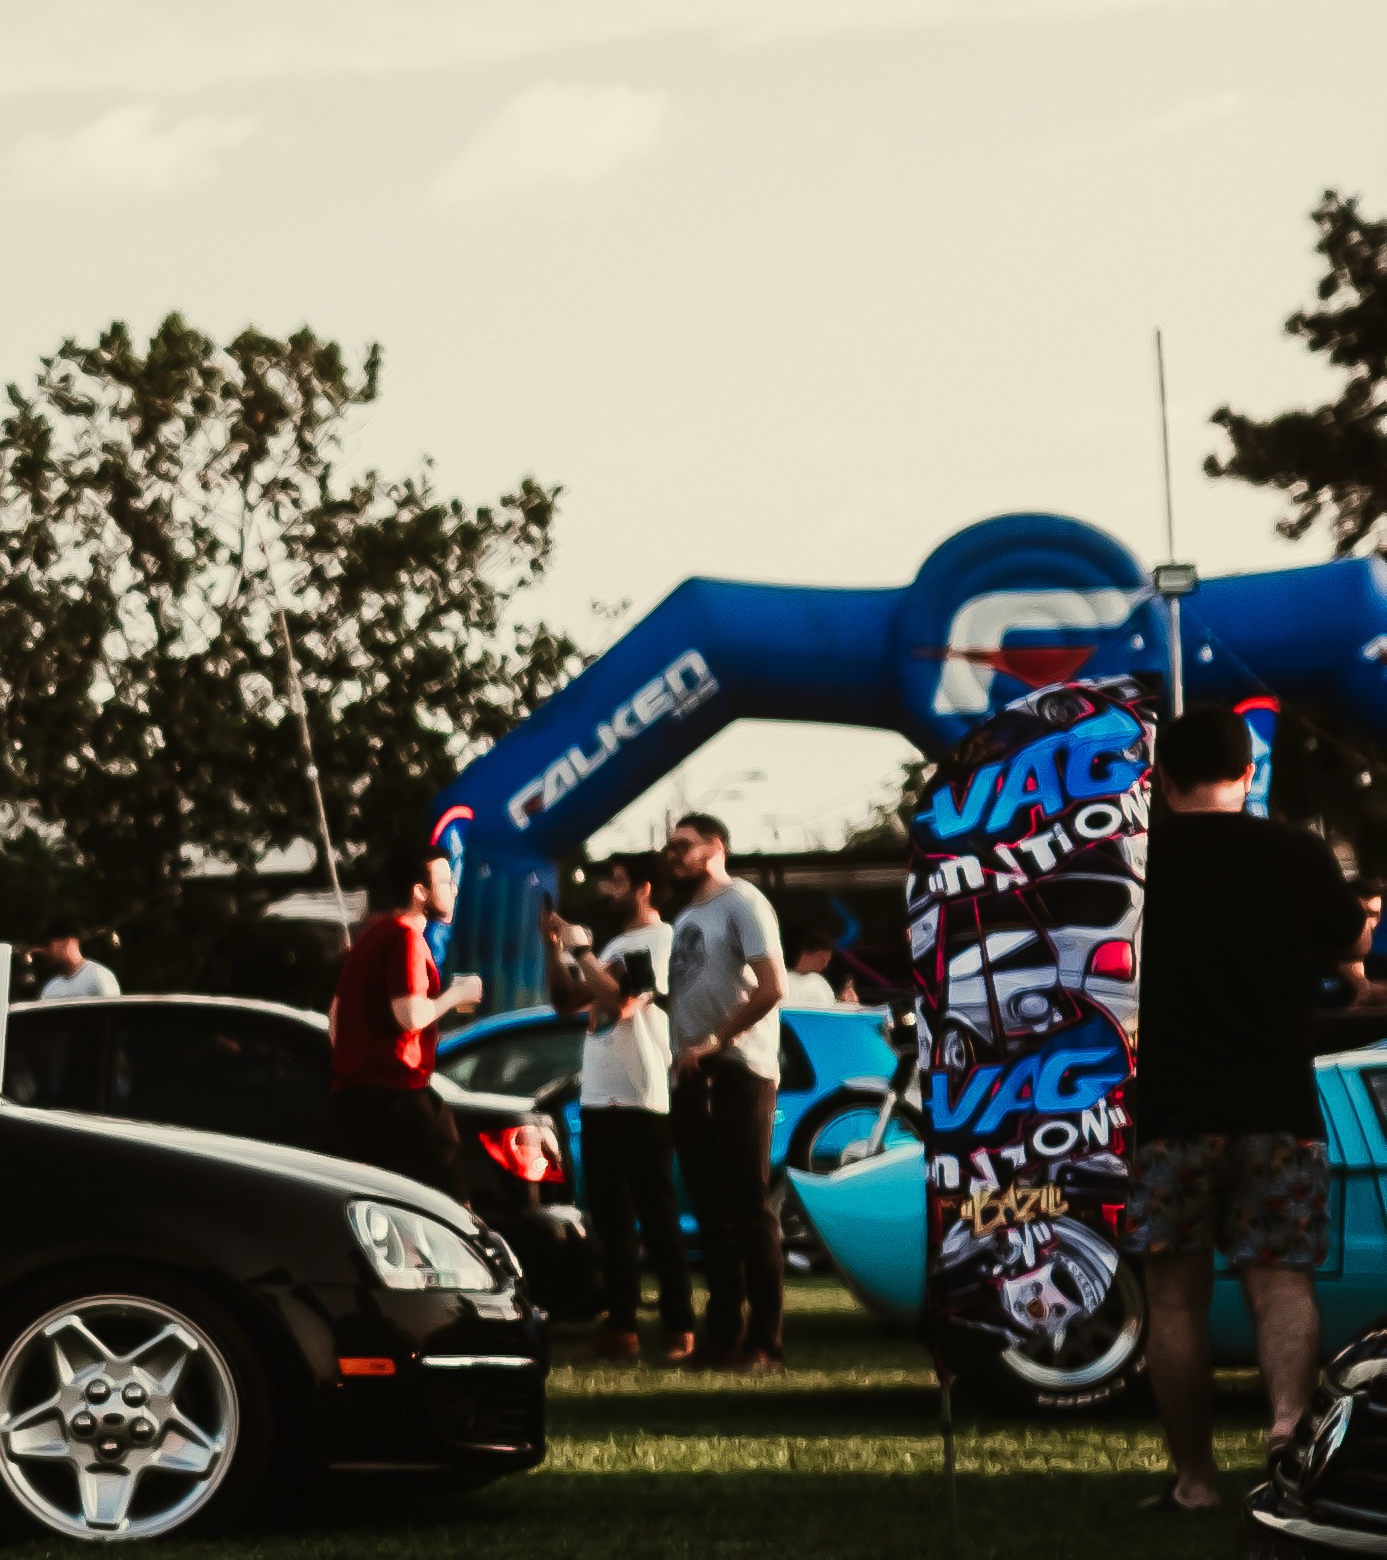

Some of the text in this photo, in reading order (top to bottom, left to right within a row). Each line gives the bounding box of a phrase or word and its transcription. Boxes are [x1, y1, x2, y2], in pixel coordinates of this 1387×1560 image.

[508, 648, 713, 829] FALKEN
[915, 705, 1147, 838] VAG
[925, 1046, 1124, 1133] VAG
